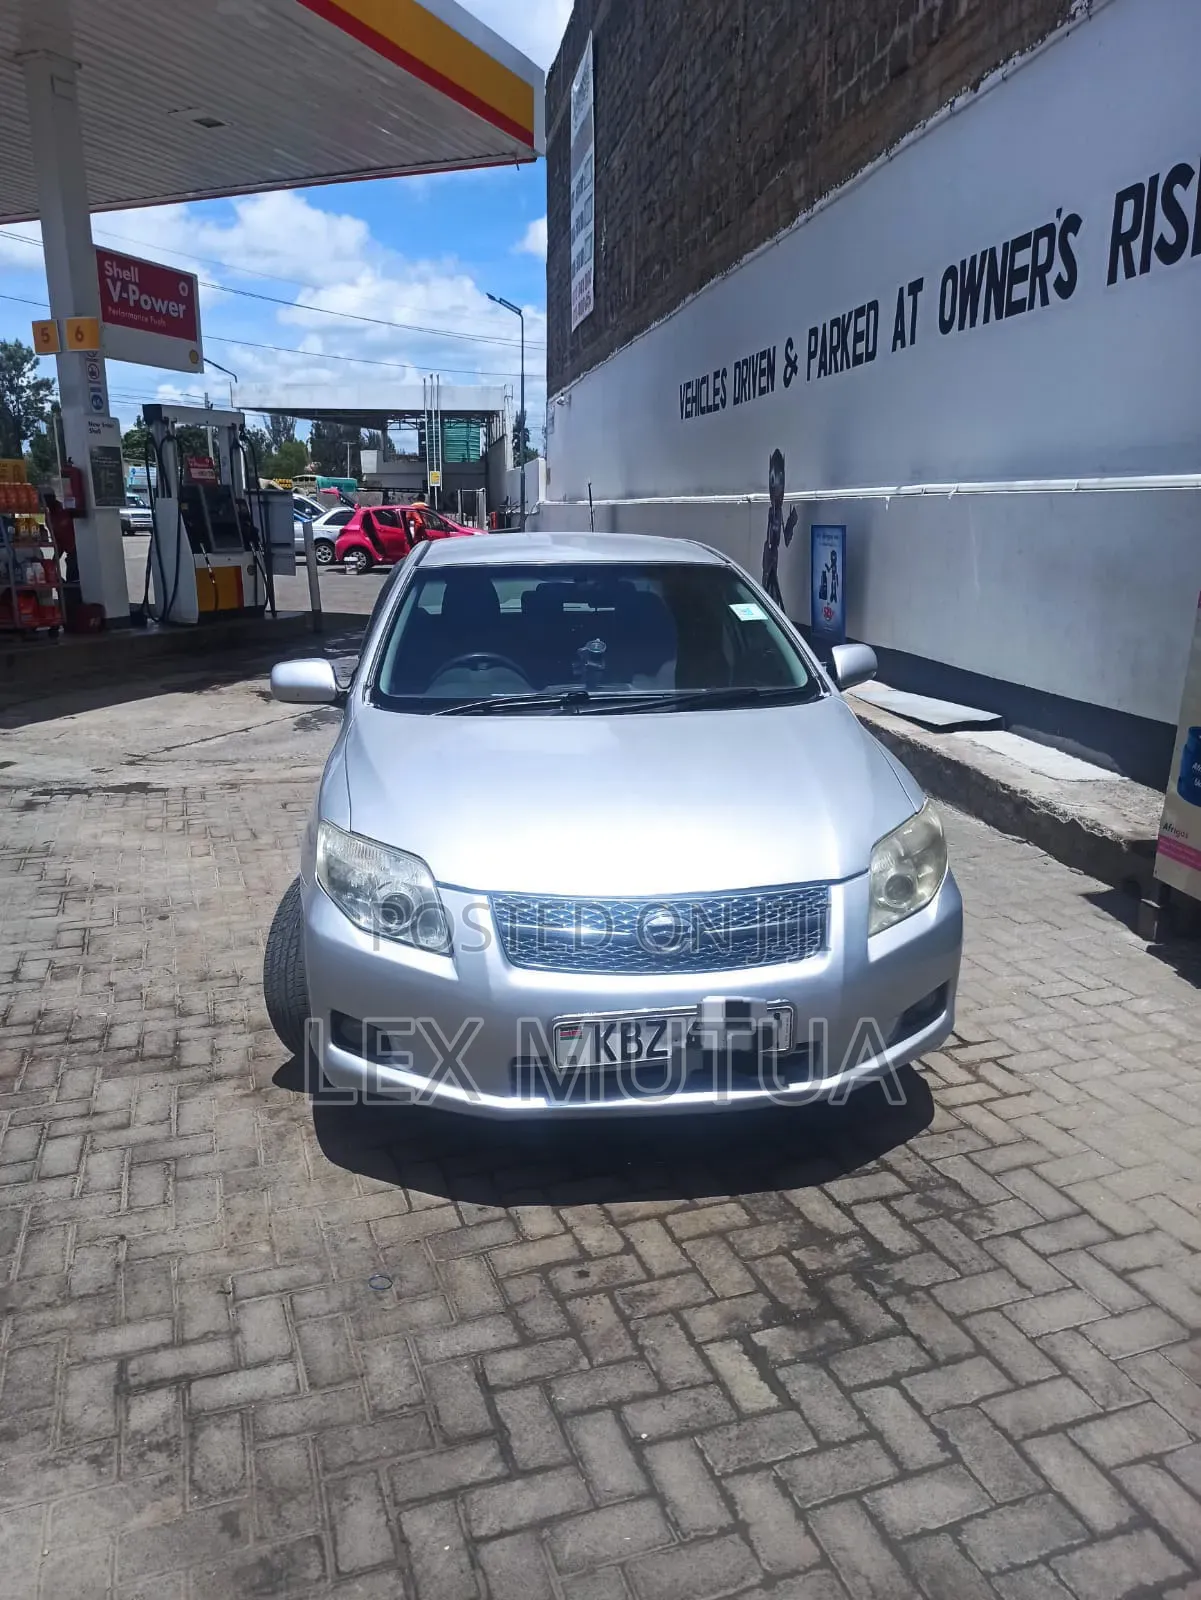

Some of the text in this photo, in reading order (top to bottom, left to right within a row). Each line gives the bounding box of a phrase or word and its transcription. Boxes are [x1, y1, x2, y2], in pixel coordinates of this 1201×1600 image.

[103, 260, 140, 283] Shell
[106, 278, 187, 319] V-Power
[679, 367, 728, 420] VEHICLES
[733, 345, 777, 406] DRIVEN
[782, 336, 798, 389] &
[806, 299, 879, 382] PARKED
[891, 277, 924, 352] AT
[939, 207, 1083, 335] OWNER'S
[40, 326, 51, 345] 5
[74, 325, 85, 343] 6
[1162, 822, 1189, 840] Afrigas
